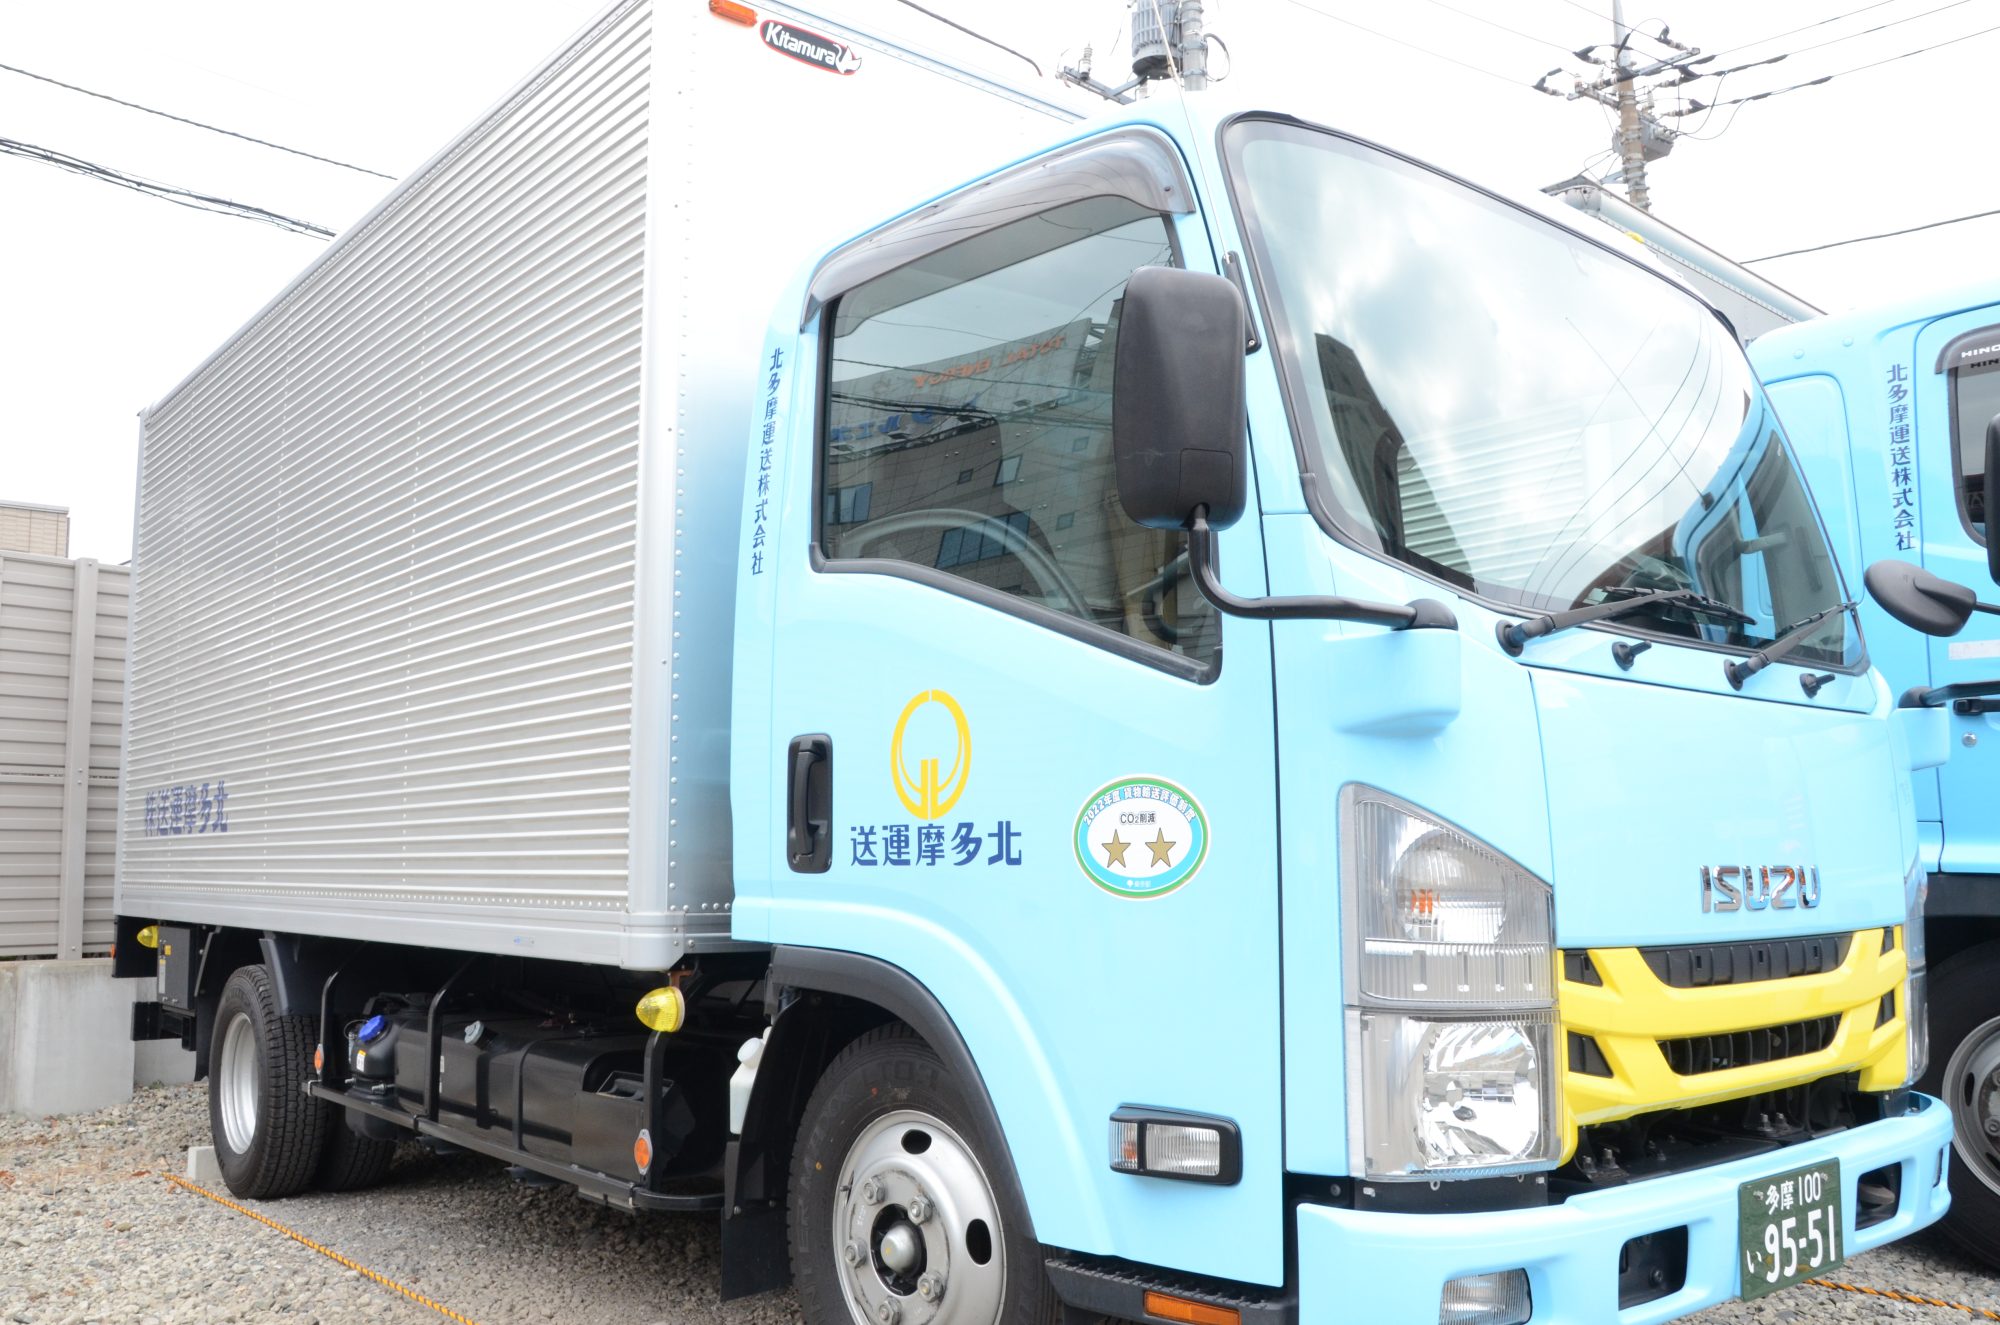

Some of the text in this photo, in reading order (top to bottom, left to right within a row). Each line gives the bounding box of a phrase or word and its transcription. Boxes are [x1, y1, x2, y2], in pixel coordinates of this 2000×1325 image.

[765, 22, 836, 65] Kitamura
[752, 347, 784, 576] 北多摩運送株式会社
[1886, 363, 1915, 551] 北多摩運送株式会社
[1701, 865, 1820, 913] ISUZU
[1765, 1172, 1821, 1215] 多摩 100
[1746, 1205, 1836, 1283] い 95-51
